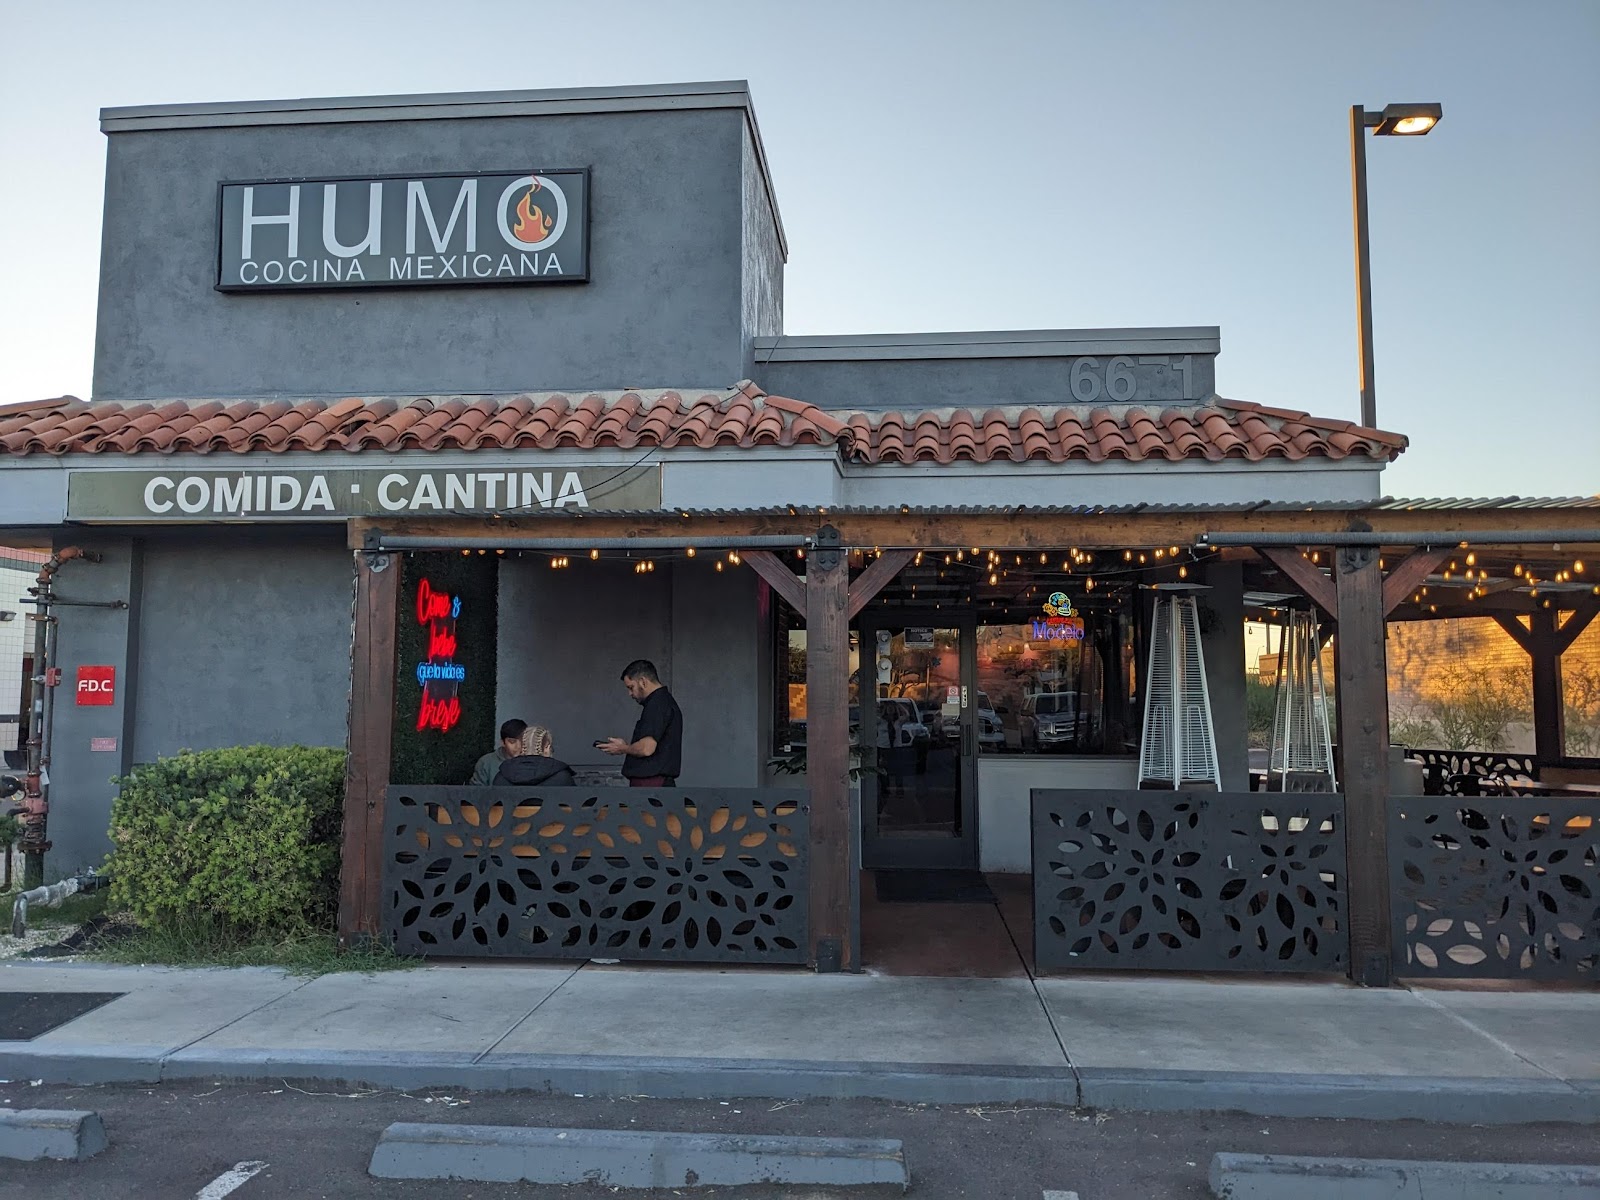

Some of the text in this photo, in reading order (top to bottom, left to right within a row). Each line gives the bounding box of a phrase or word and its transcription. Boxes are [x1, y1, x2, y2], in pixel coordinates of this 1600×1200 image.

[241, 175, 568, 260] HUMO
[239, 252, 564, 284] COCINA MEXICANA
[143, 471, 589, 513] COMIDA CANTINA
[1032, 620, 1085, 640] Modelo
[78, 679, 114, 692] F.D.C.
